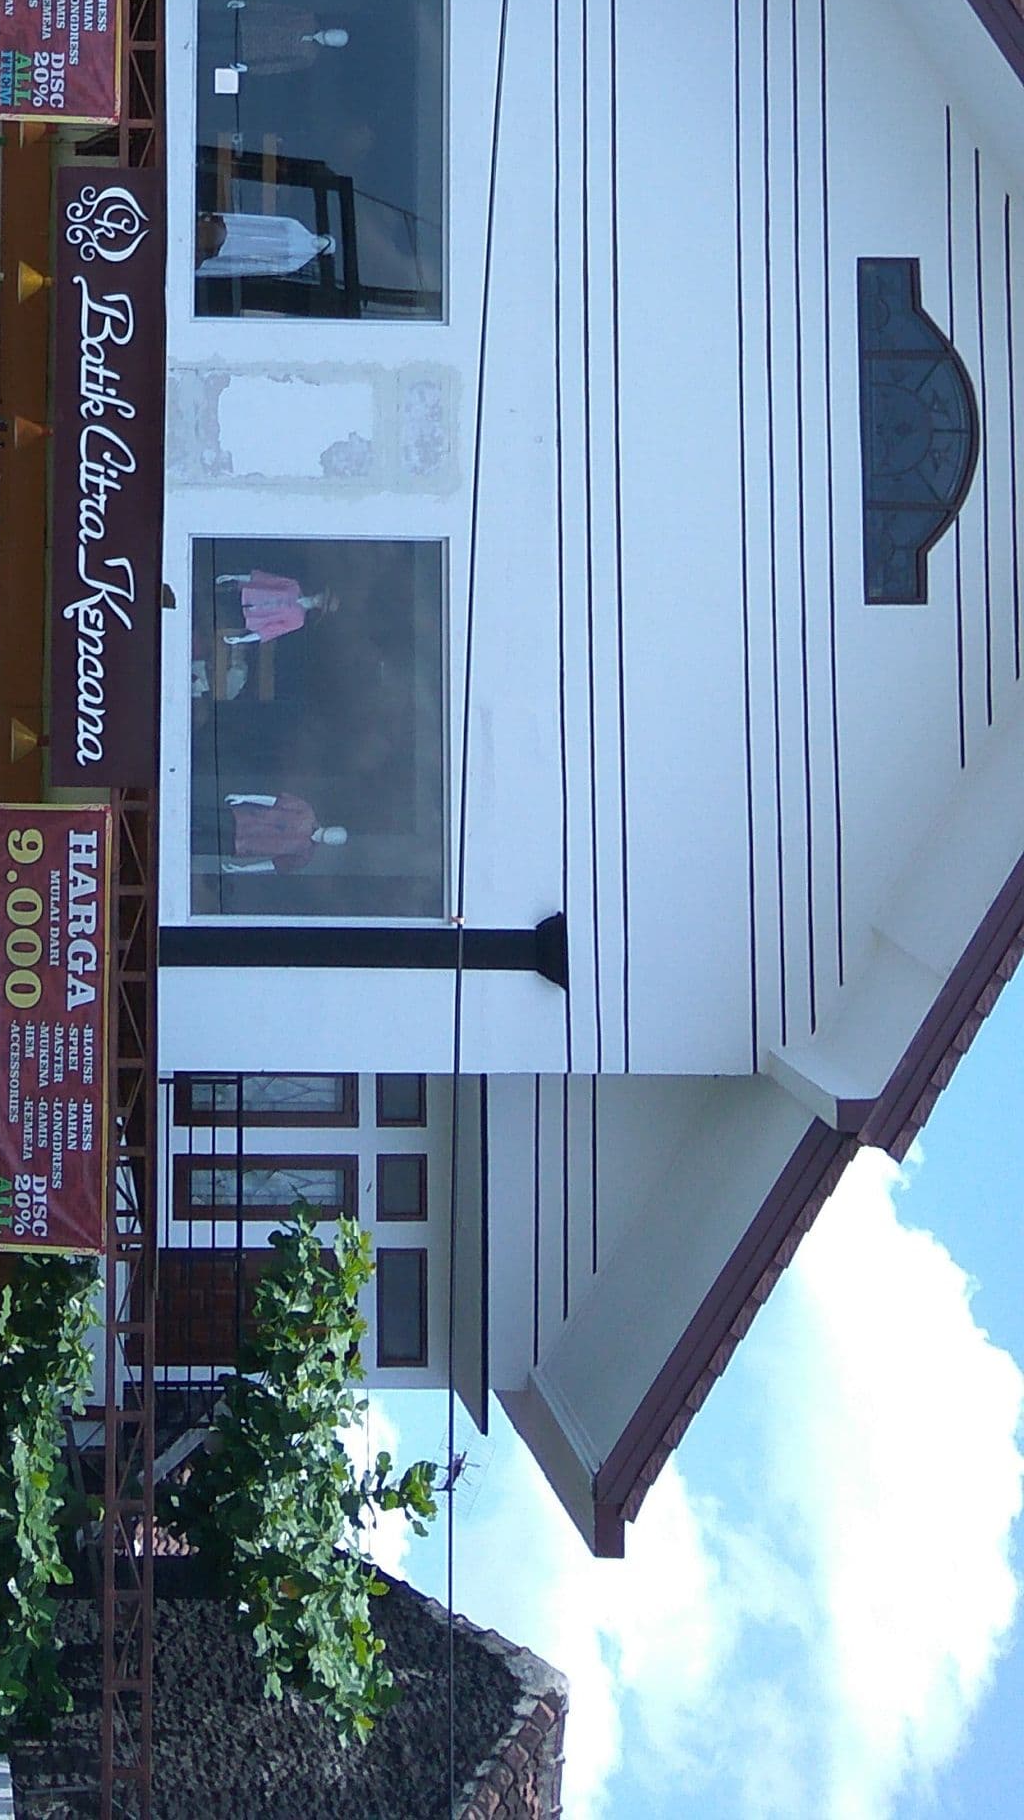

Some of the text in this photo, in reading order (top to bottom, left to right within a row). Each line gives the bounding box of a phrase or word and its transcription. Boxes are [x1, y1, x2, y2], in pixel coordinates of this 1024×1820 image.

[0, 50, 13, 106] ITEM
[13, 51, 31, 106] ALL
[33, 51, 49, 107] 20%
[48, 52, 65, 108] DISC
[71, 276, 135, 418] Batik
[77, 424, 136, 543] Citra
[63, 544, 135, 766] Kencana
[4, 827, 44, 1009] 9.000
[49, 870, 61, 966] MULAI DARI
[66, 829, 98, 1011] HARGA
[14, 1173, 31, 1236] 20%
[32, 1175, 48, 1237] DISC
